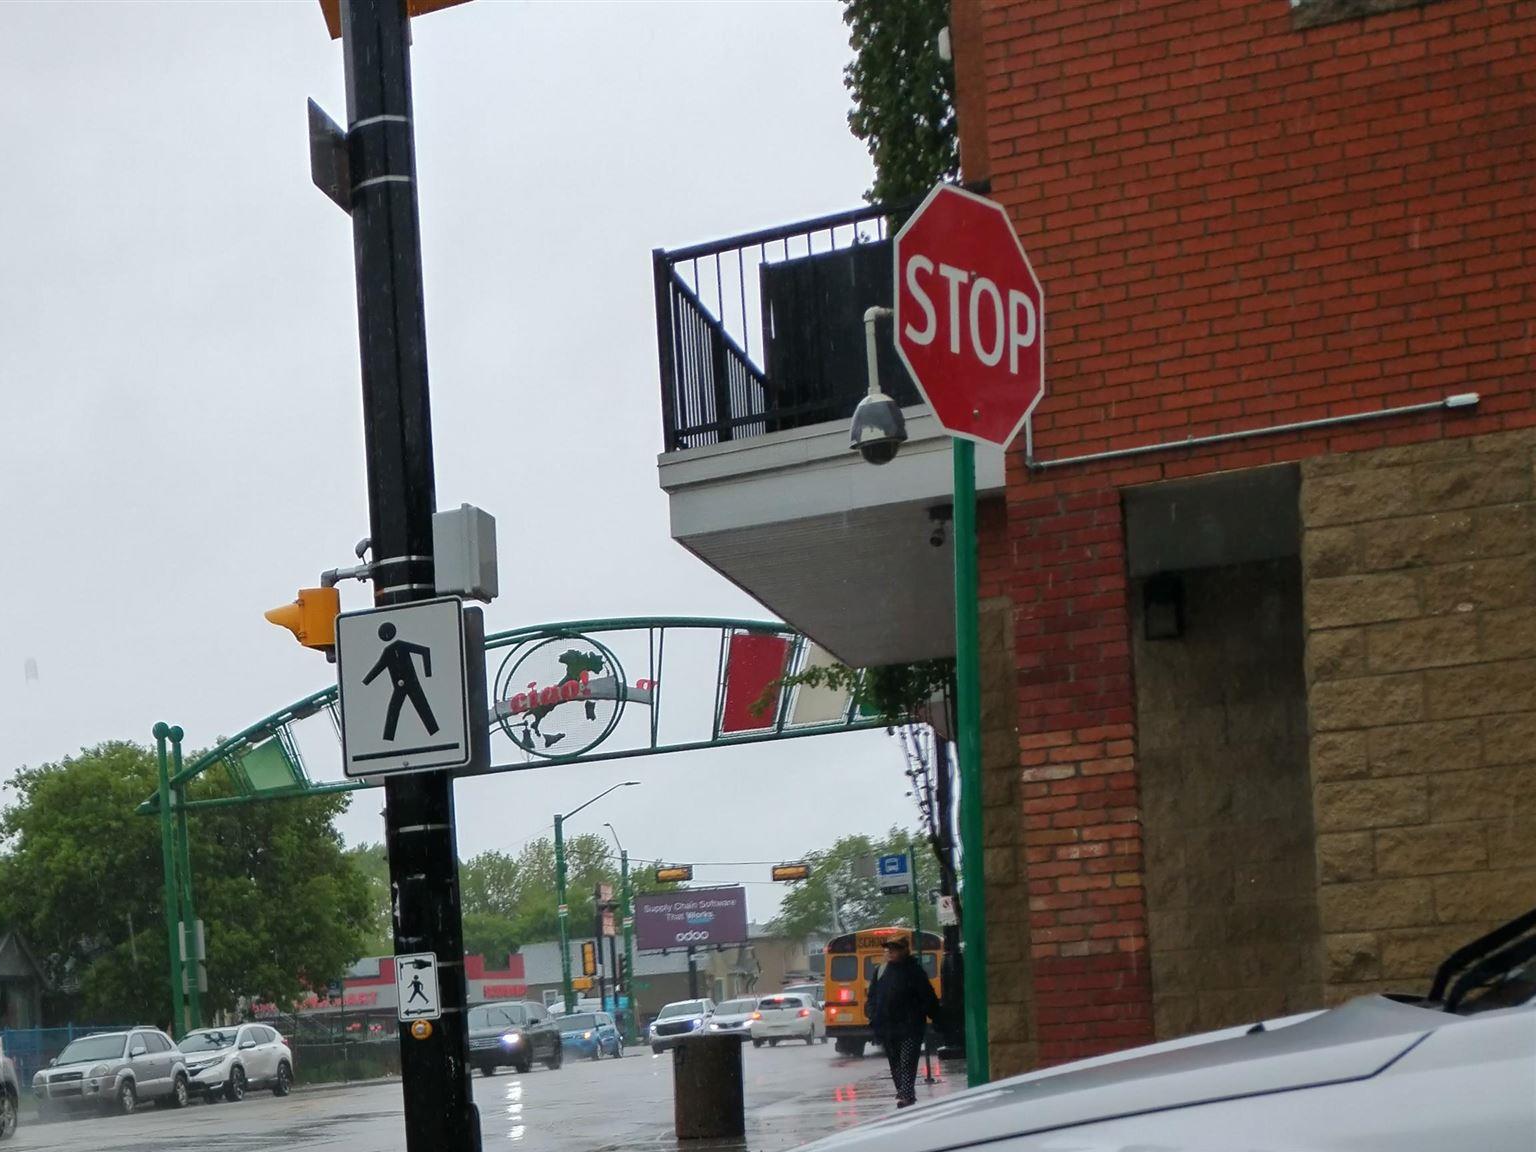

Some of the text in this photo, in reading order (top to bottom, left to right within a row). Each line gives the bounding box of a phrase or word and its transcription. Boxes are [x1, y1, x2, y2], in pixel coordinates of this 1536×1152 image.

[904, 254, 1037, 375] STOP
[510, 670, 592, 713] ciao!
[644, 899, 736, 913] Supply Chain Software
[666, 912, 685, 921] That
[675, 929, 710, 941] odoo
